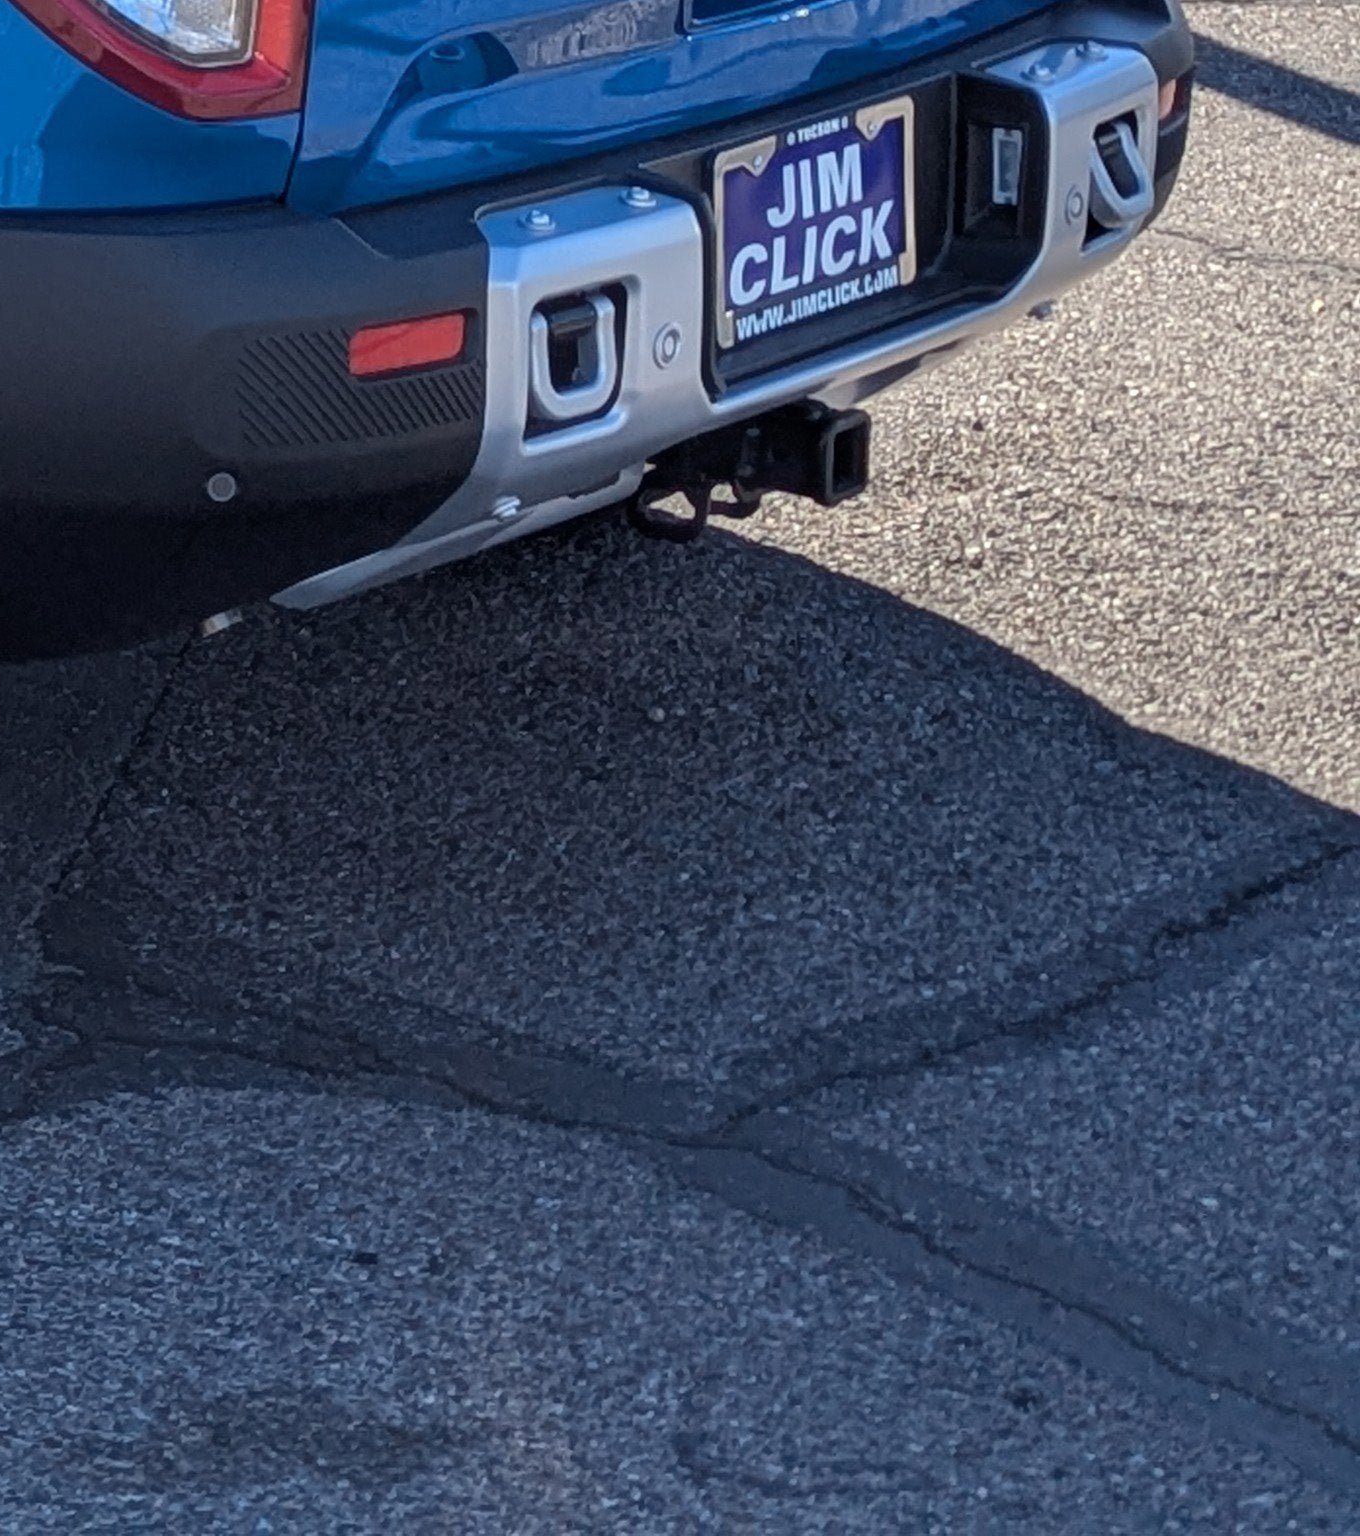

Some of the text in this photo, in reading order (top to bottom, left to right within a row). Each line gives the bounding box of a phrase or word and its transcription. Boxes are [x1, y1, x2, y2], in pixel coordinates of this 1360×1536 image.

[796, 117, 841, 144] TUCSON
[766, 142, 864, 229] JIM
[729, 199, 895, 307] CLICK
[736, 264, 899, 341] WWW.JIMCLICK.COM
